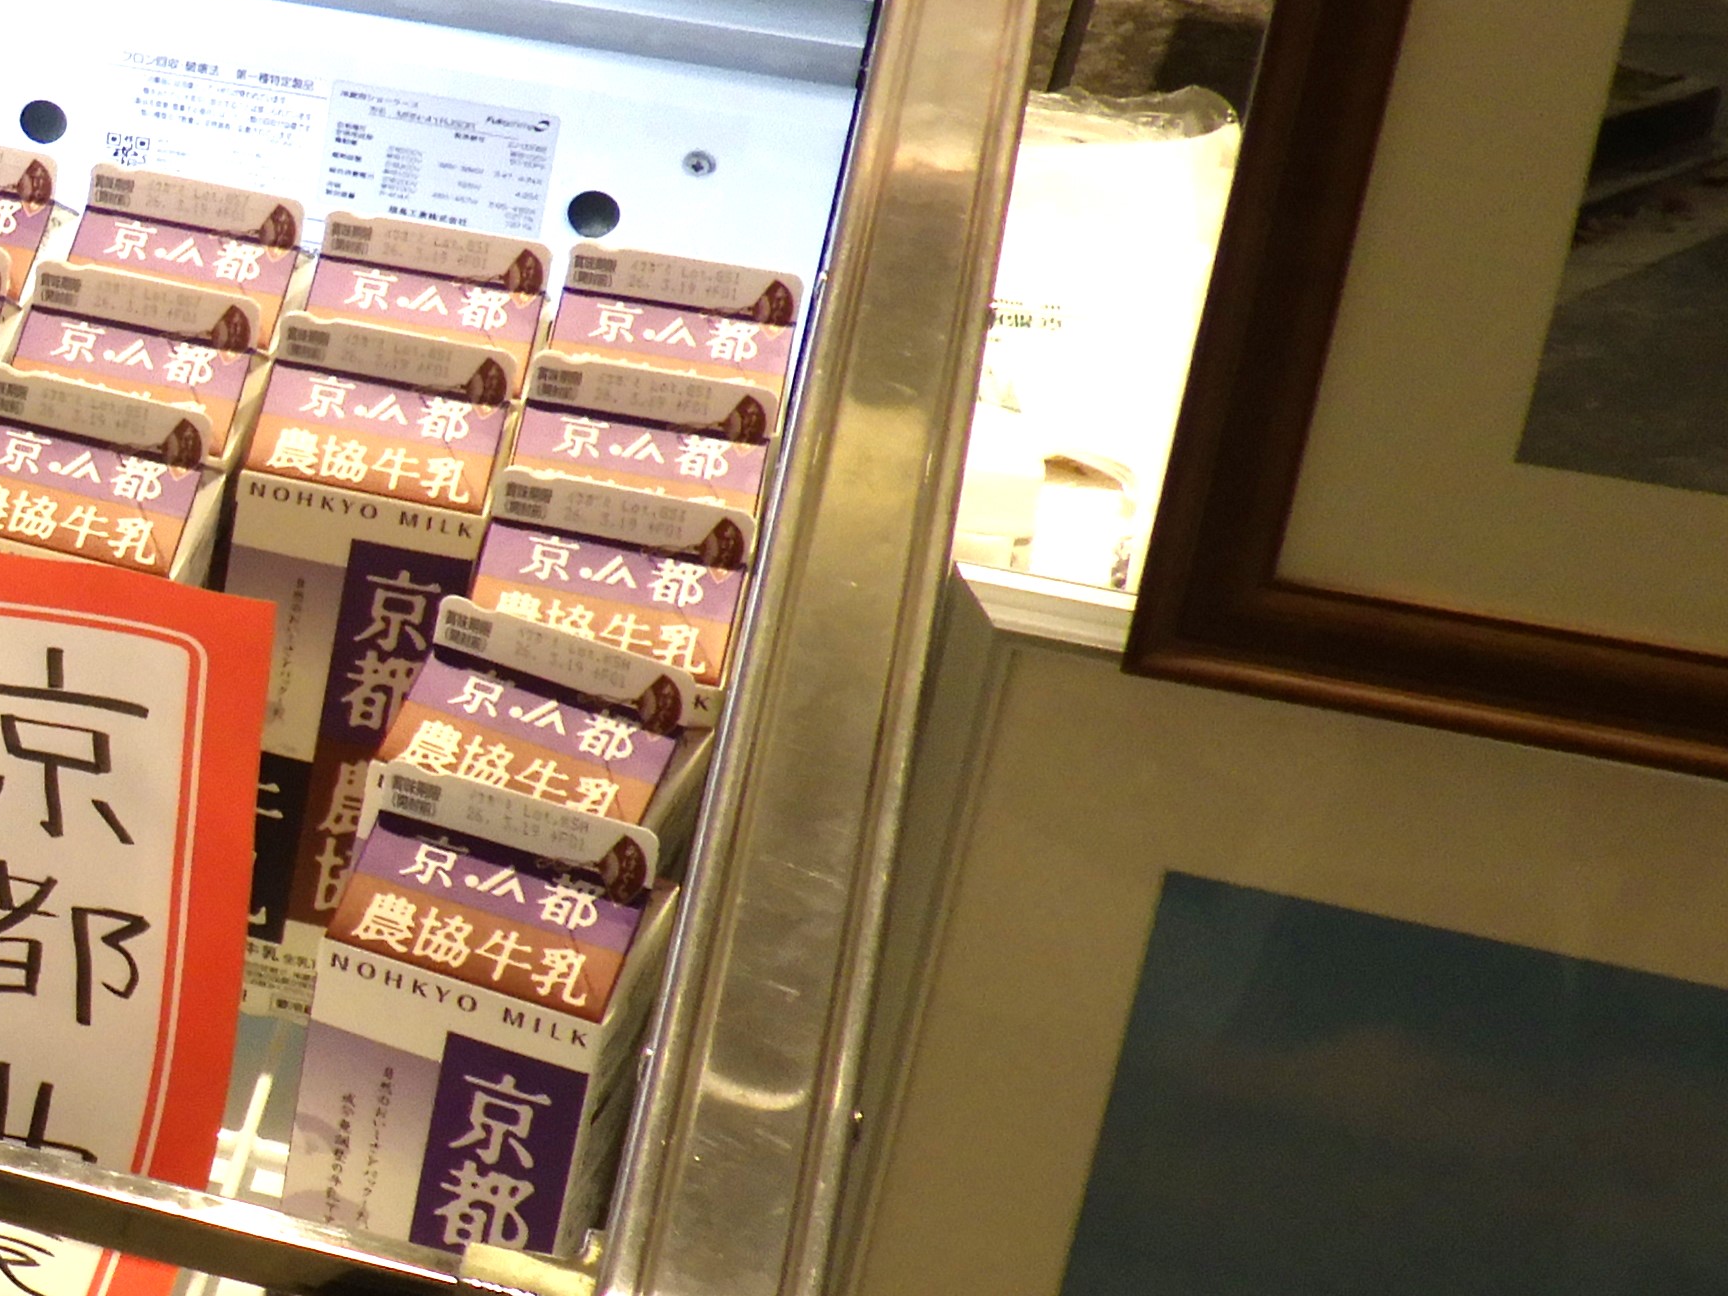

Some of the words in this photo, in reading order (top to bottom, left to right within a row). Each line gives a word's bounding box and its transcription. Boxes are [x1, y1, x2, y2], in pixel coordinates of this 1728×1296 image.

[266, 428, 472, 503] 農協牛乳
[248, 480, 378, 524] NOHKYO
[399, 510, 475, 540] MILK
[352, 892, 587, 1008] 農協牛乳
[331, 952, 478, 1014] NOHKYO
[503, 1006, 589, 1049] MILK
